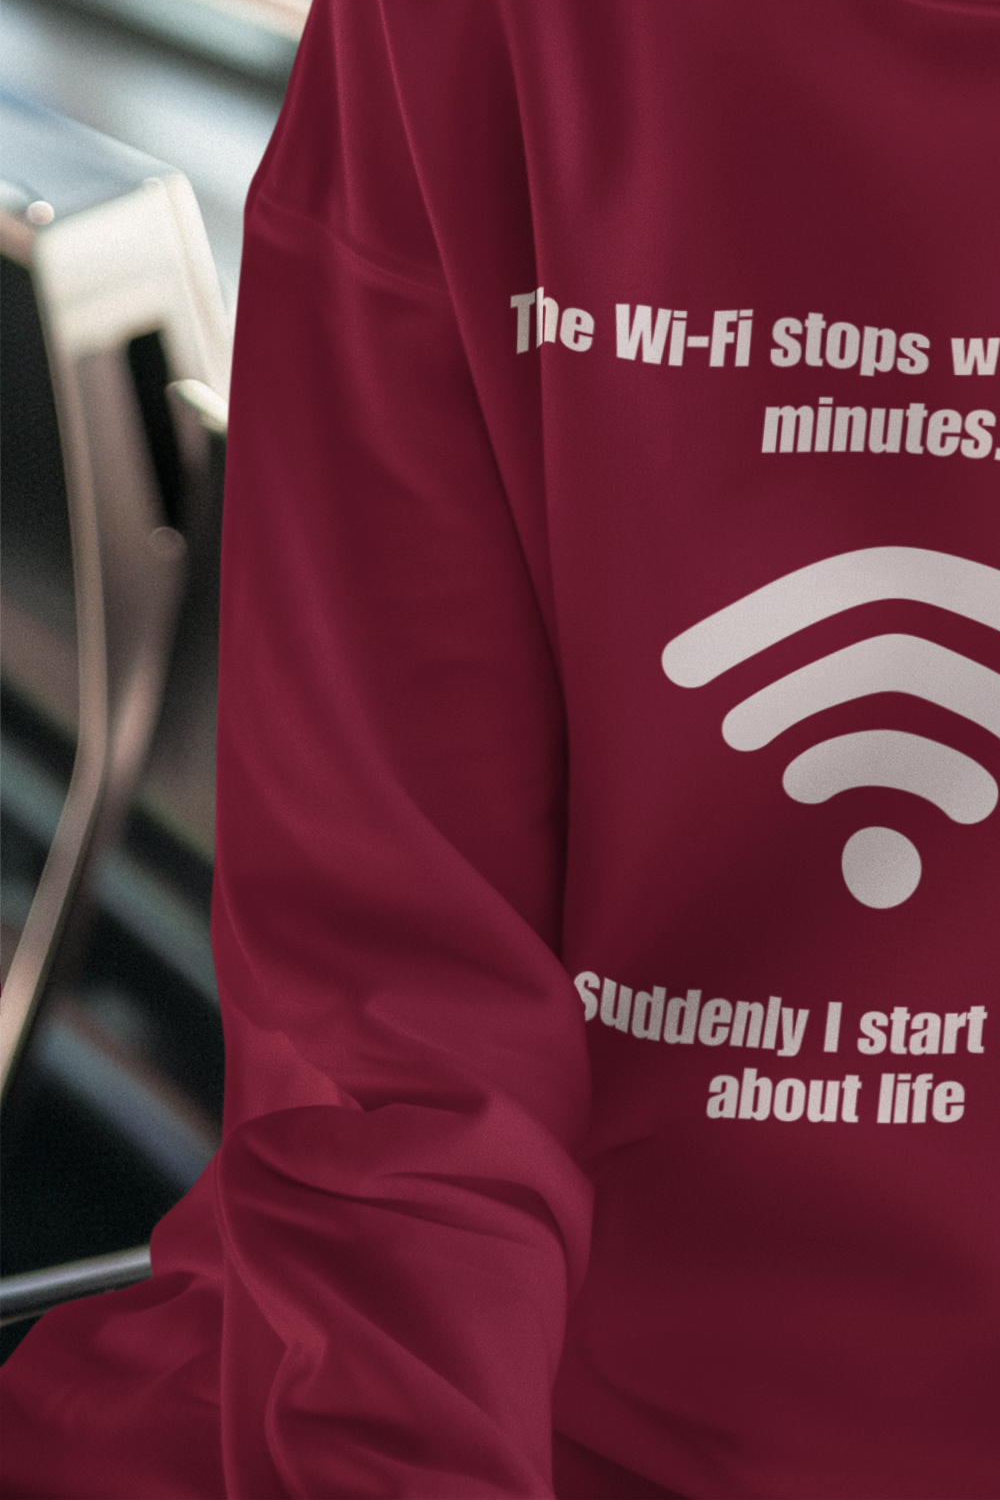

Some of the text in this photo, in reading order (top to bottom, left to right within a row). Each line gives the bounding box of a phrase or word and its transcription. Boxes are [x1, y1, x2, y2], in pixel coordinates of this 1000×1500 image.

[510, 286, 595, 354] The
[614, 303, 754, 367] Wi-Fi
[769, 312, 931, 377] stops
[823, 1001, 843, 1053] I
[857, 1005, 989, 1056] start
[706, 1067, 966, 1125] about life
